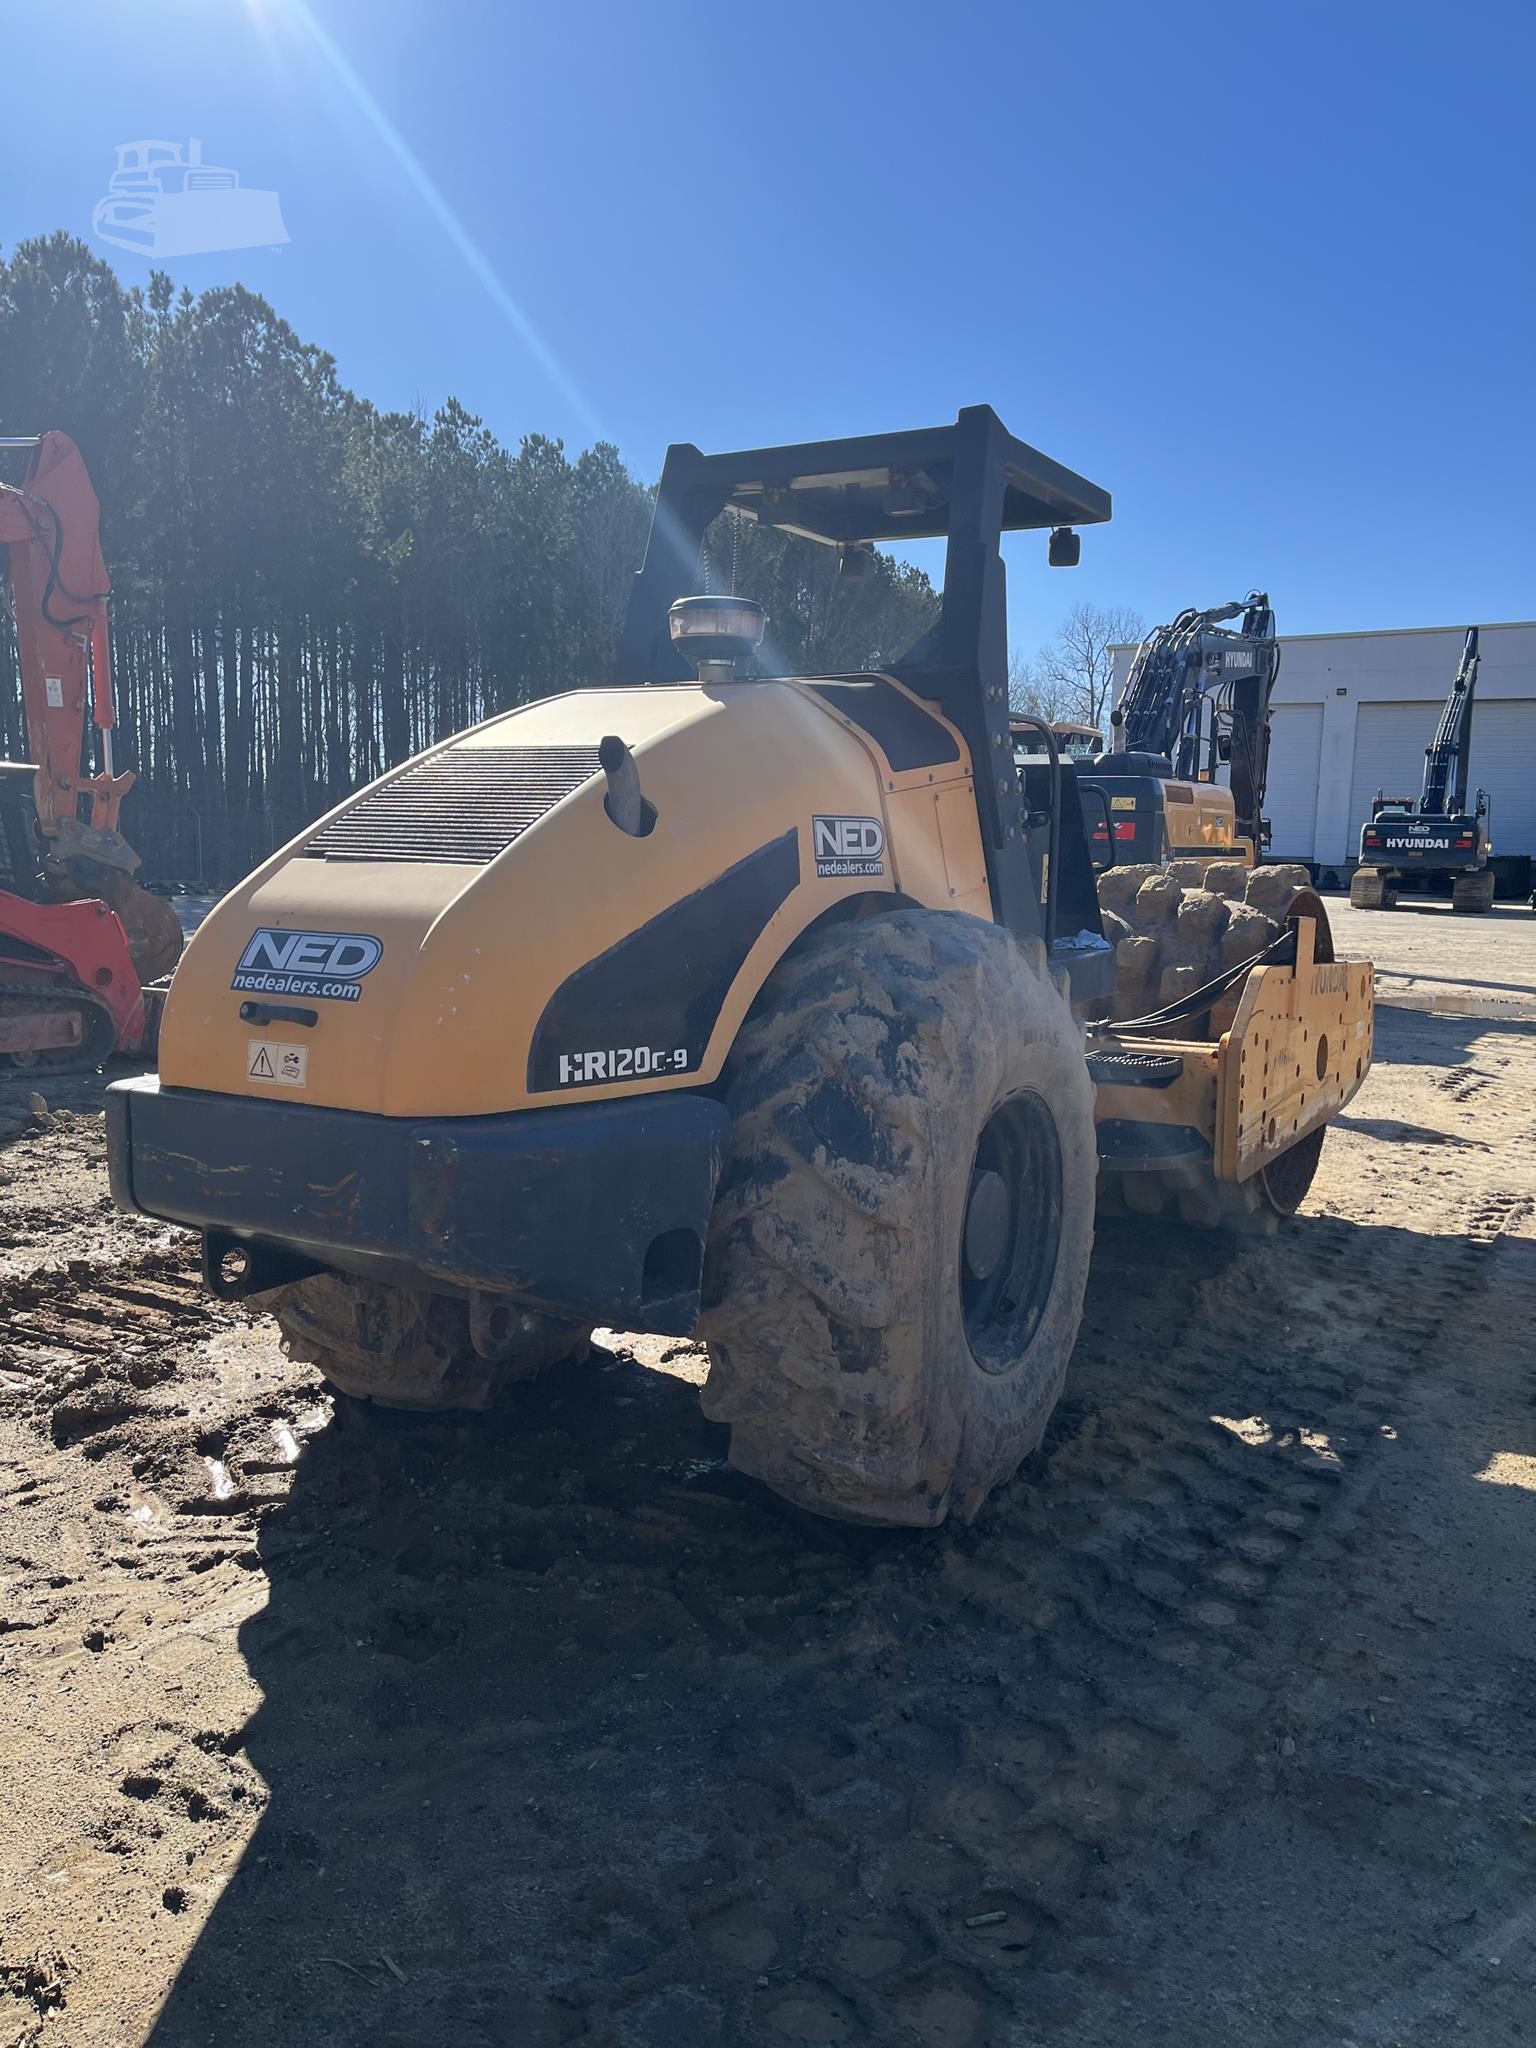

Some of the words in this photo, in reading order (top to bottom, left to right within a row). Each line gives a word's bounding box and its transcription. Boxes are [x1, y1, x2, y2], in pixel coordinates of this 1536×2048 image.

[1225, 651, 1253, 667] HYUNDAI
[815, 820, 883, 856] NED
[1386, 838, 1449, 849] HYUNDAI
[818, 860, 883, 875] nedealers.com
[242, 932, 380, 975] NED
[233, 973, 361, 999] nedealers.com
